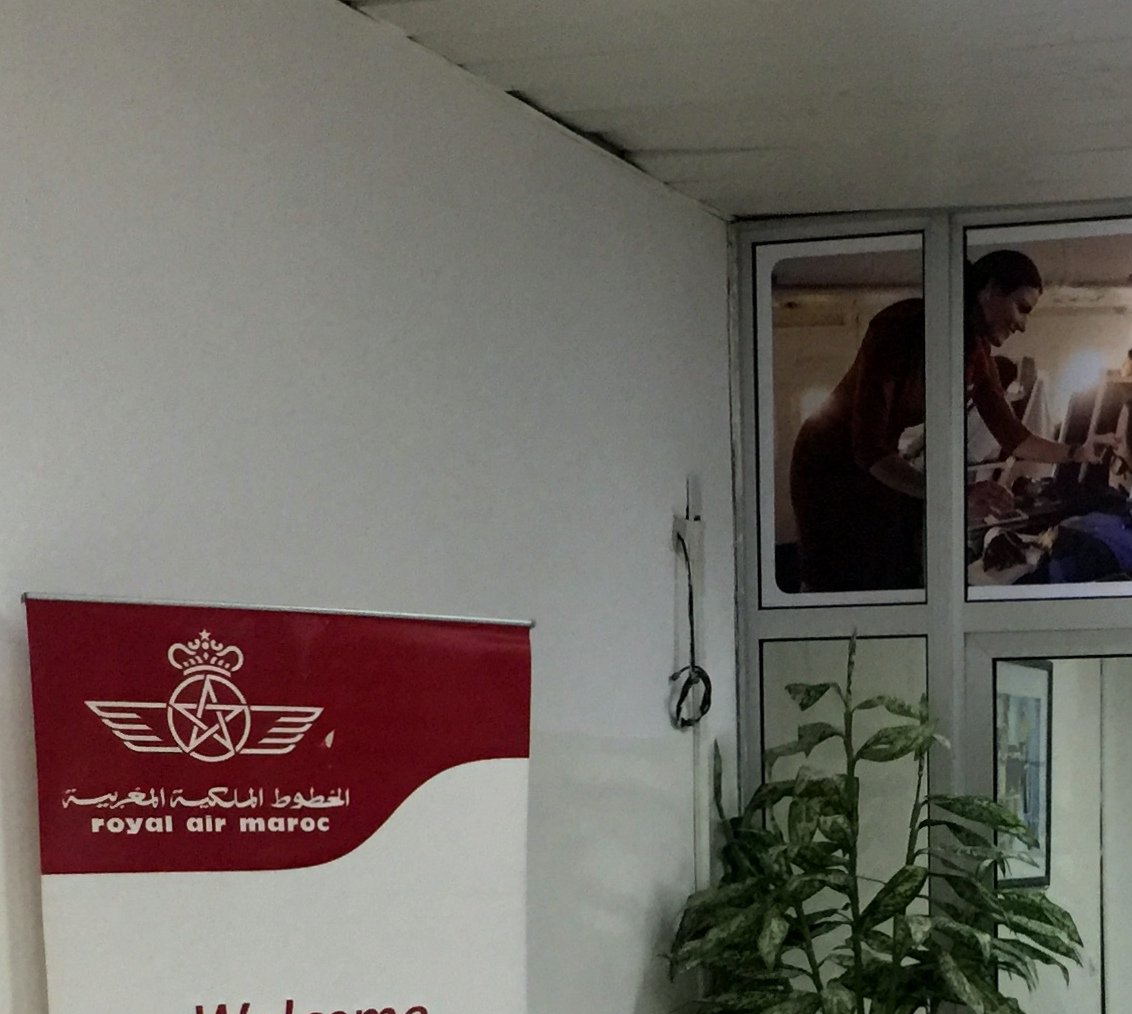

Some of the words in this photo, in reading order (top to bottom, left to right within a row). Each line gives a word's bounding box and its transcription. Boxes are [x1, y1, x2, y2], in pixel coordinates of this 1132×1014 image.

[91, 815, 173, 834] royal
[186, 815, 226, 832] air
[240, 816, 330, 833] maroc
